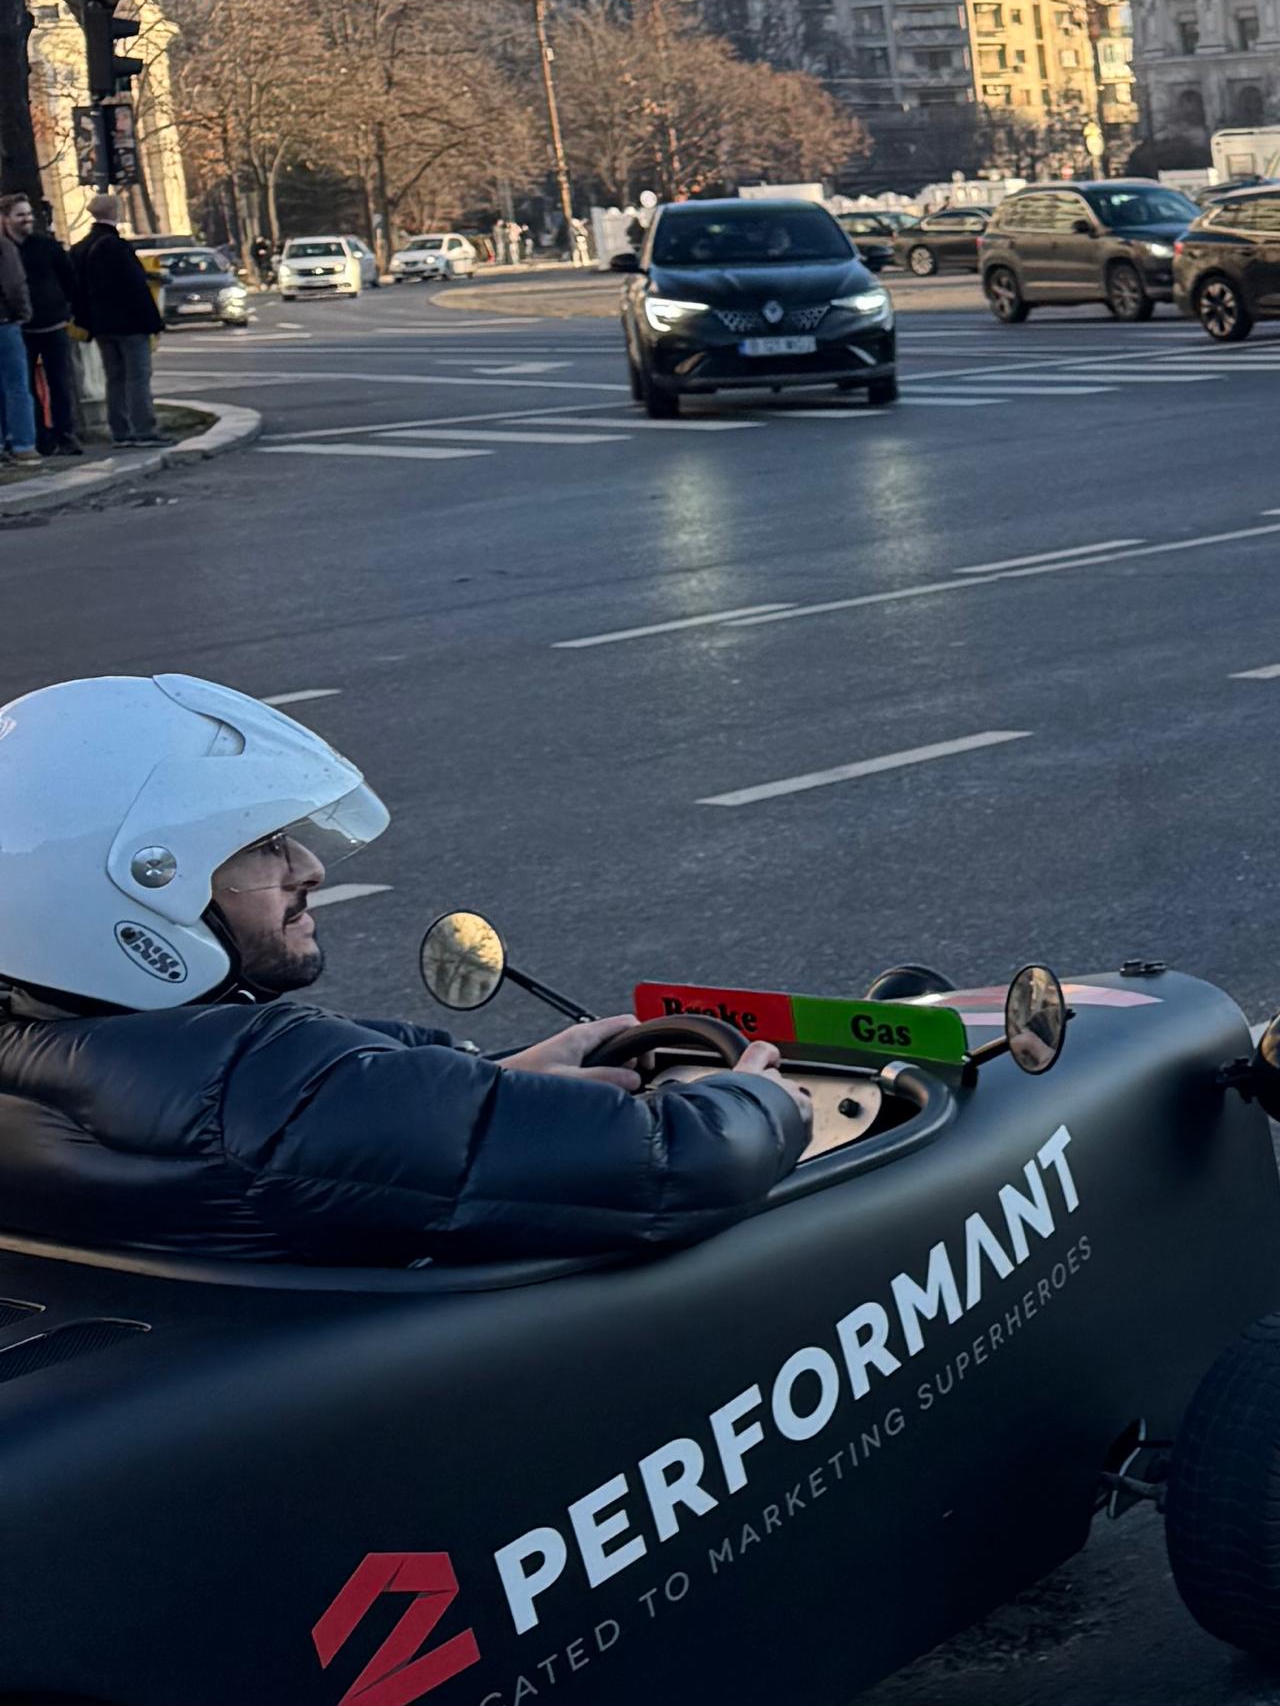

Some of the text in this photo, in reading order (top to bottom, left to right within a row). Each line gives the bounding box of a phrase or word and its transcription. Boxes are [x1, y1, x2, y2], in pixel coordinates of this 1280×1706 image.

[850, 1014, 912, 1047] Gas
[638, 1571, 690, 1618] TO
[708, 1407, 906, 1574] MARKETING
[917, 1235, 1092, 1411] SUPERHEROES
